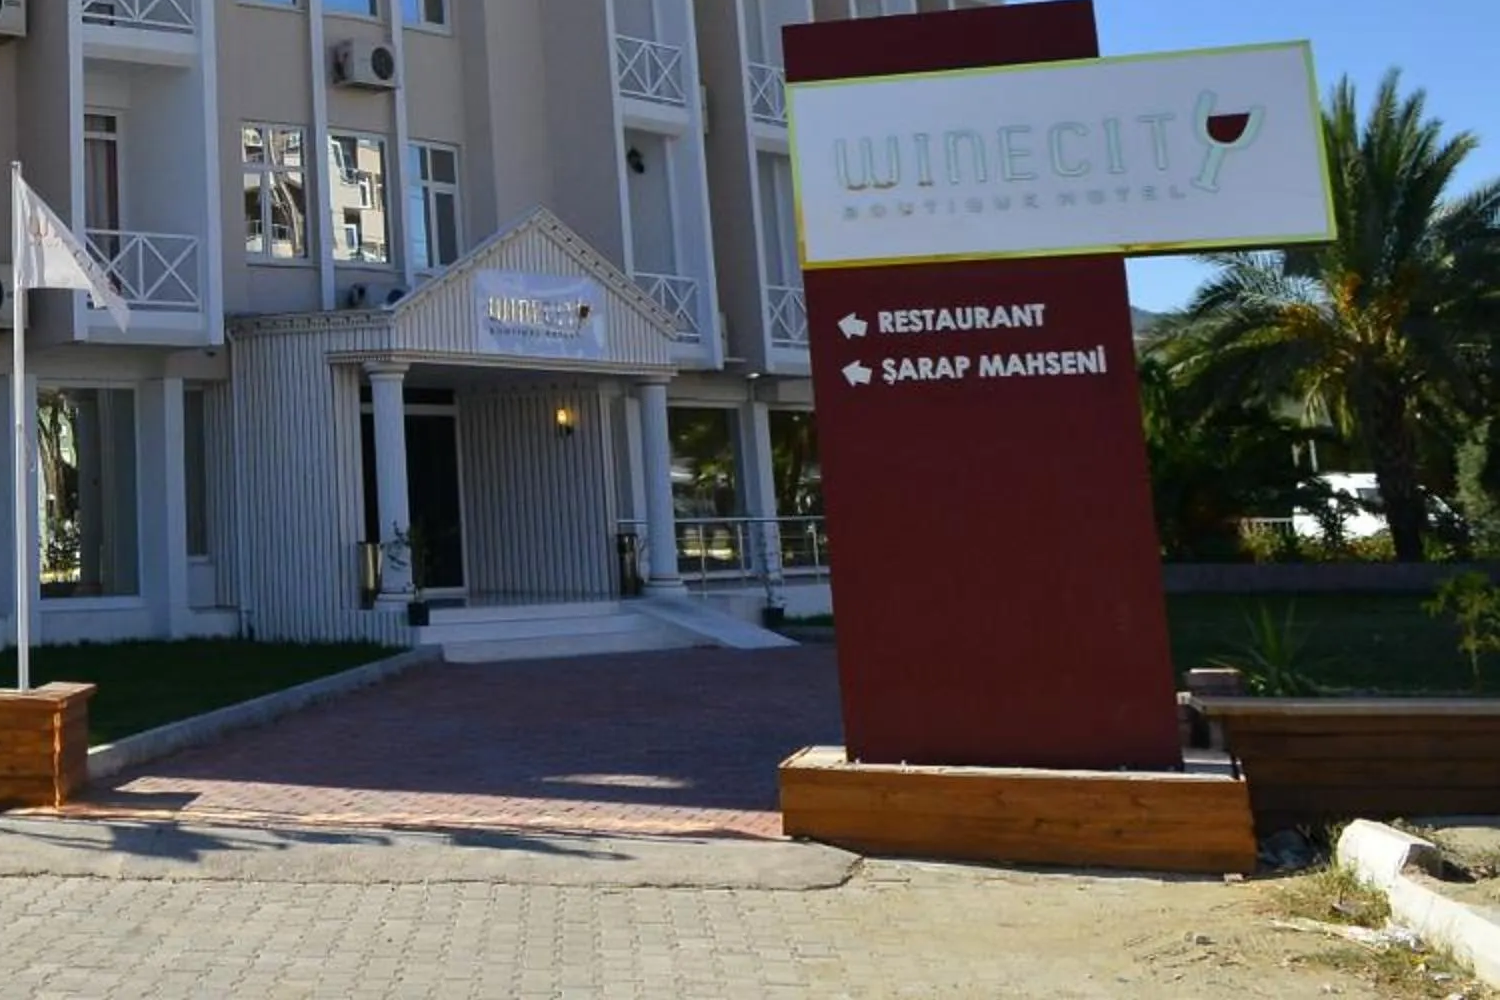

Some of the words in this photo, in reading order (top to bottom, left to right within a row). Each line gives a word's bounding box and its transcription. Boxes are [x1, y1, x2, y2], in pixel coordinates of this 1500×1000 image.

[877, 303, 1046, 334] RESTAURANT
[881, 355, 971, 386] ŞARAP
[977, 344, 1108, 378] MAHSENİ
